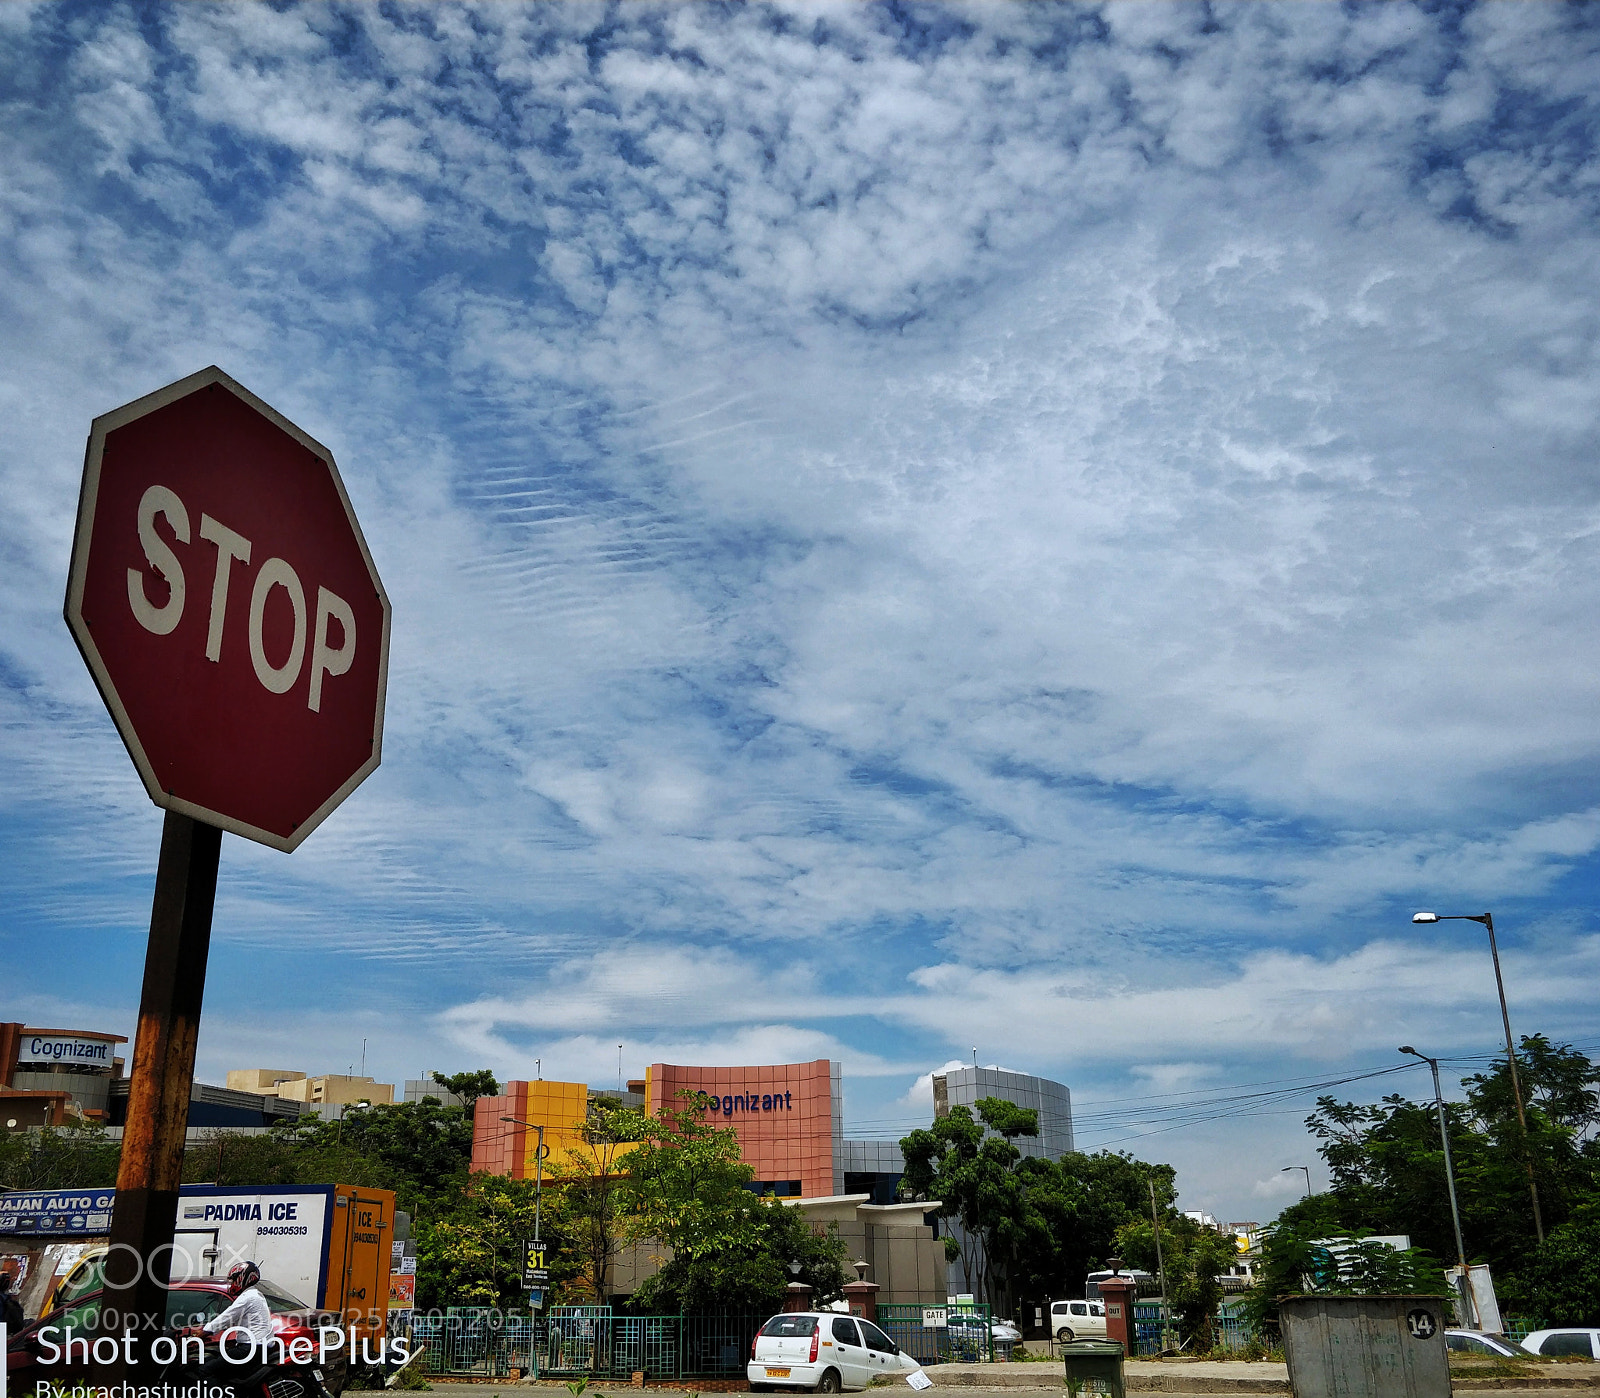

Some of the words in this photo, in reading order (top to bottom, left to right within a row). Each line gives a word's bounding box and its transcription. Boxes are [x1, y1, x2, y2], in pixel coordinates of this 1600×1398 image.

[127, 485, 357, 714] STOP
[31, 1038, 107, 1059] Cognizant
[697, 1090, 792, 1115] Cognizant
[46, 1197, 92, 1210] AUTO
[204, 1203, 262, 1221] PADMA
[268, 1202, 298, 1221] ICE
[358, 1211, 372, 1227] ICE
[256, 1226, 308, 1236] 9940305313
[528, 1242, 547, 1251] VILLAS
[527, 1250, 544, 1269] 31
[926, 1311, 944, 1319] GATE
[1109, 1307, 1120, 1315] OUT
[1408, 1314, 1433, 1335] 14
